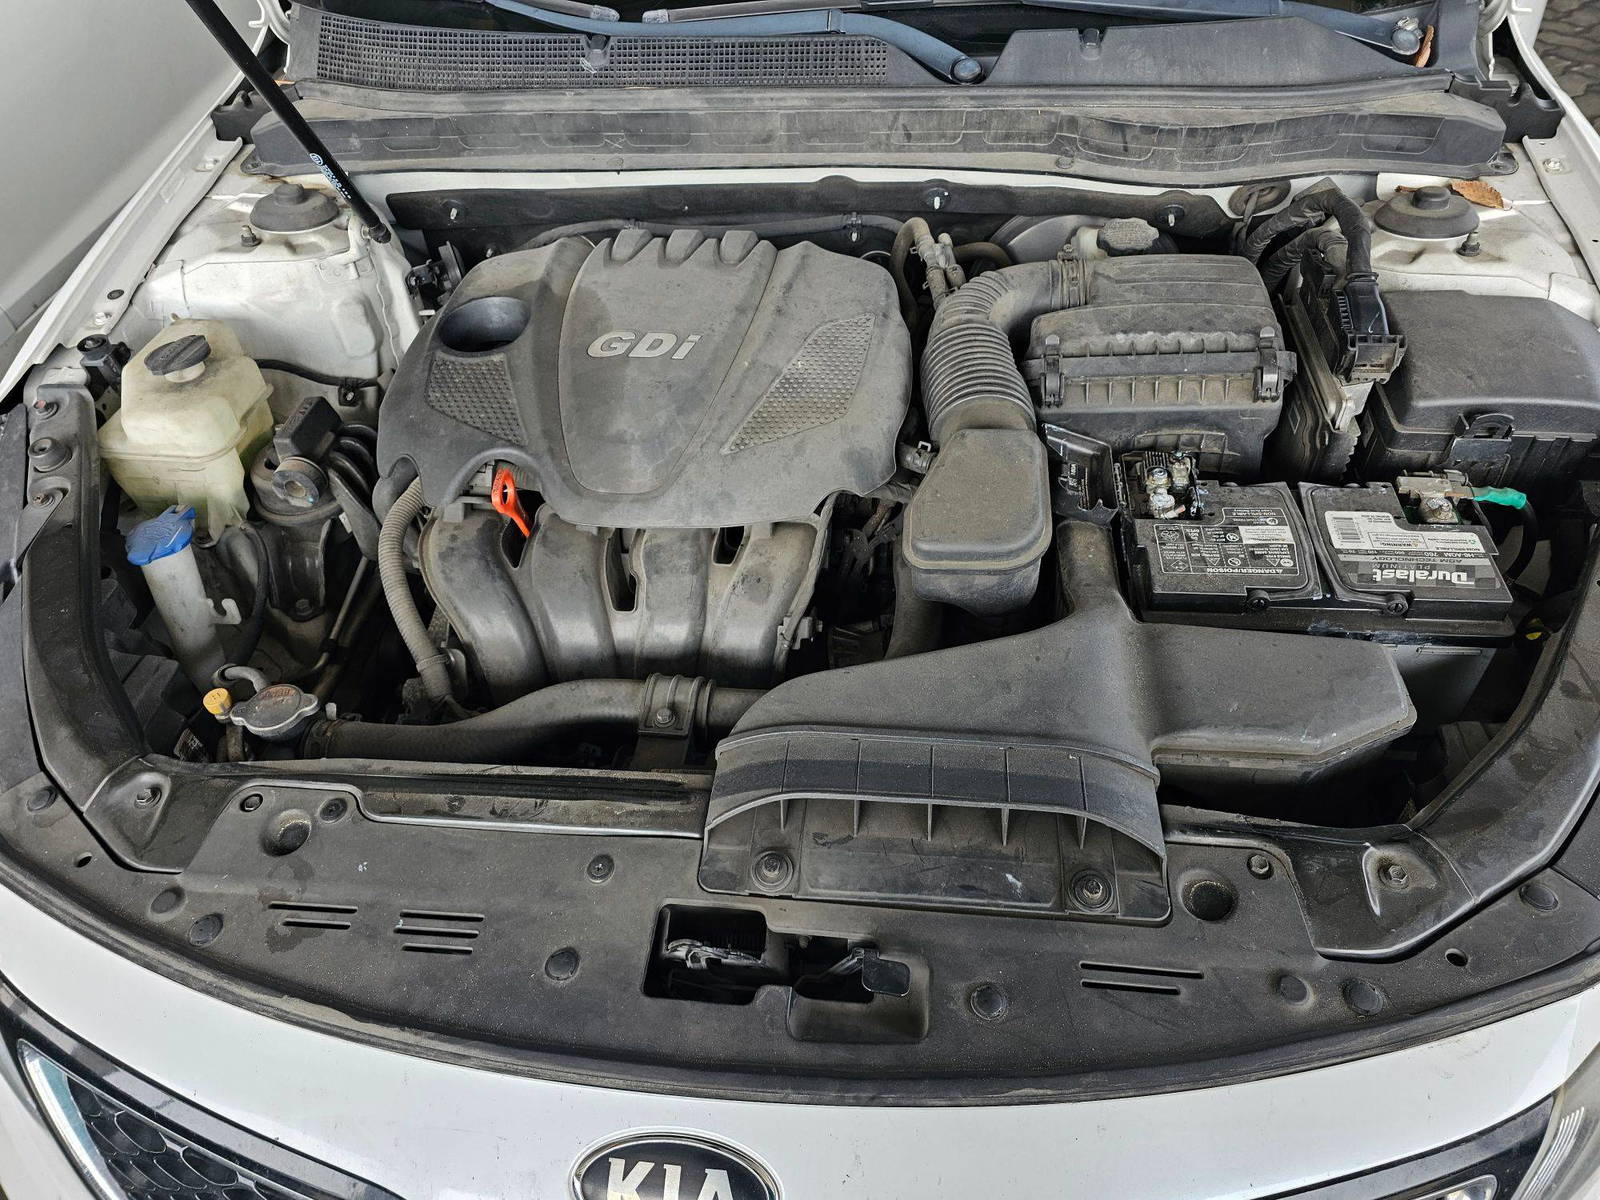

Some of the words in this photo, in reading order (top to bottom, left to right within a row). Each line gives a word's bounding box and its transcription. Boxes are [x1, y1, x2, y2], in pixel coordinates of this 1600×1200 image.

[587, 331, 702, 360] GDi
[1372, 568, 1475, 585] Duralast
[607, 1157, 733, 1200] KIA
